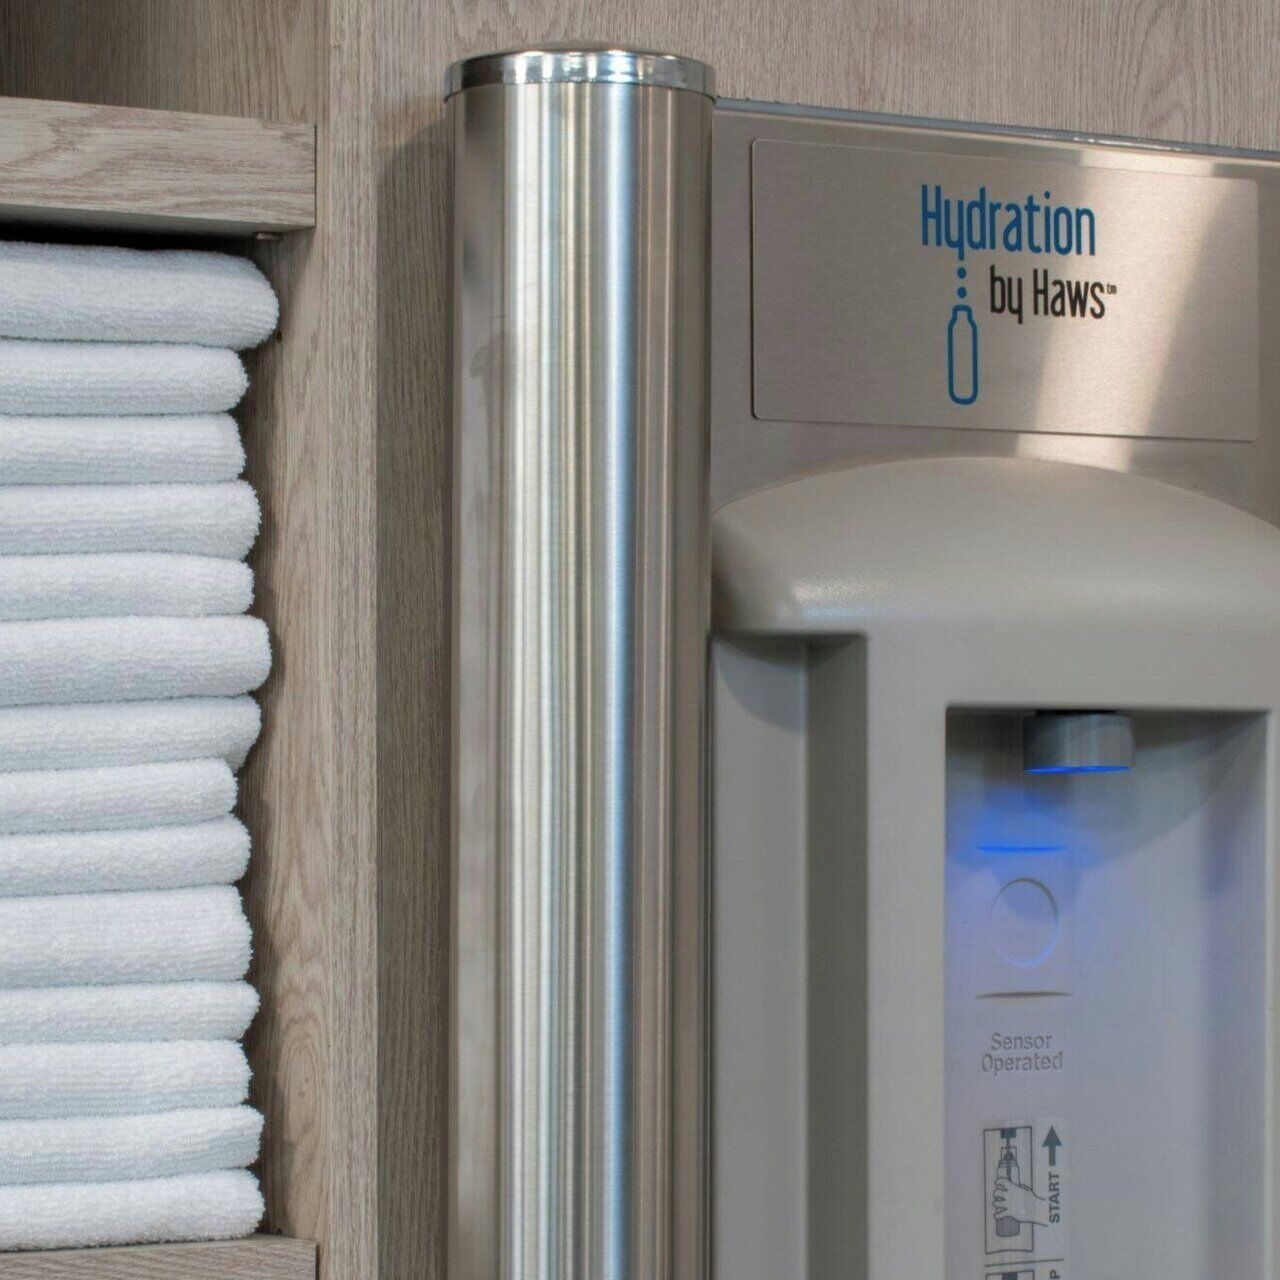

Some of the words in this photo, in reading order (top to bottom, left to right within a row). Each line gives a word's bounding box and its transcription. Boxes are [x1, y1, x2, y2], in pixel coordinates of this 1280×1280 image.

[921, 184, 1096, 261] Hydration
[990, 264, 1023, 325] by
[981, 1052, 1064, 1075] Operated
[990, 1032, 1054, 1051] Sensor
[1048, 1171, 1061, 1224] START
